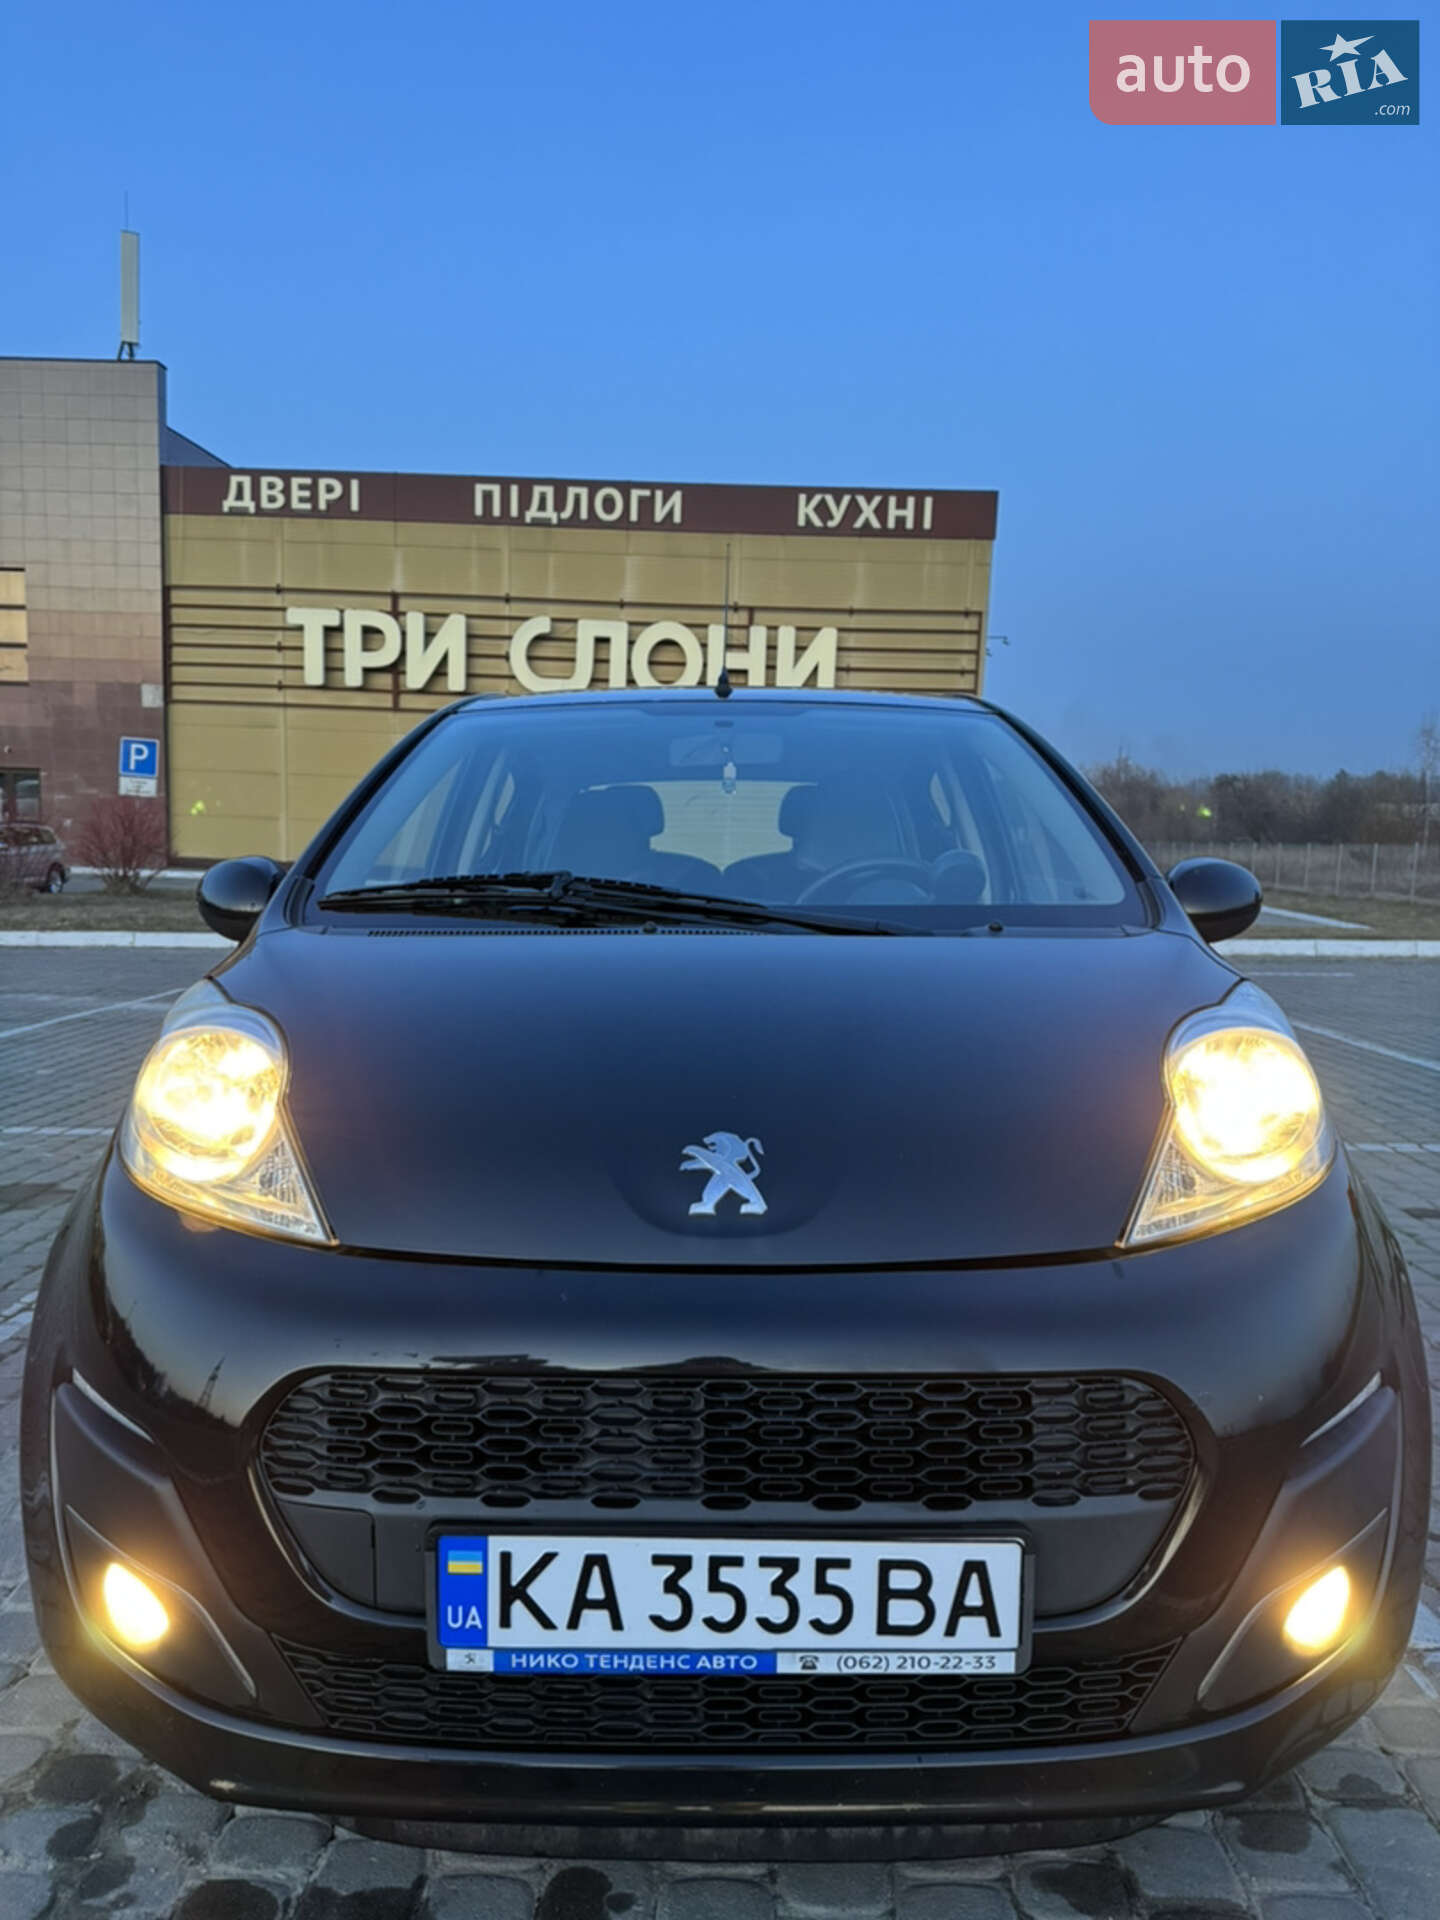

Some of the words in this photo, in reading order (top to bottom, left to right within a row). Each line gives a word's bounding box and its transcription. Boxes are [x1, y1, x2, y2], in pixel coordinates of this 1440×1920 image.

[222, 474, 361, 514] ДВЕРІ
[473, 483, 683, 525] ПІДЛОГИ
[796, 493, 934, 531] КУХНІ
[285, 607, 467, 692] ТРИ
[508, 615, 838, 693] СЛОНИ
[129, 743, 149, 771] P
[498, 1550, 625, 1632] KA
[648, 1553, 855, 1637] 3535
[875, 1558, 1003, 1639] BA
[447, 1604, 483, 1630] UA
[510, 1653, 580, 1670] НИКО
[585, 1654, 692, 1672] ТЕНДЕНС
[695, 1655, 758, 1671] АВТО
[836, 1655, 891, 1673] (062)
[896, 1655, 997, 1672] 210-22-33
